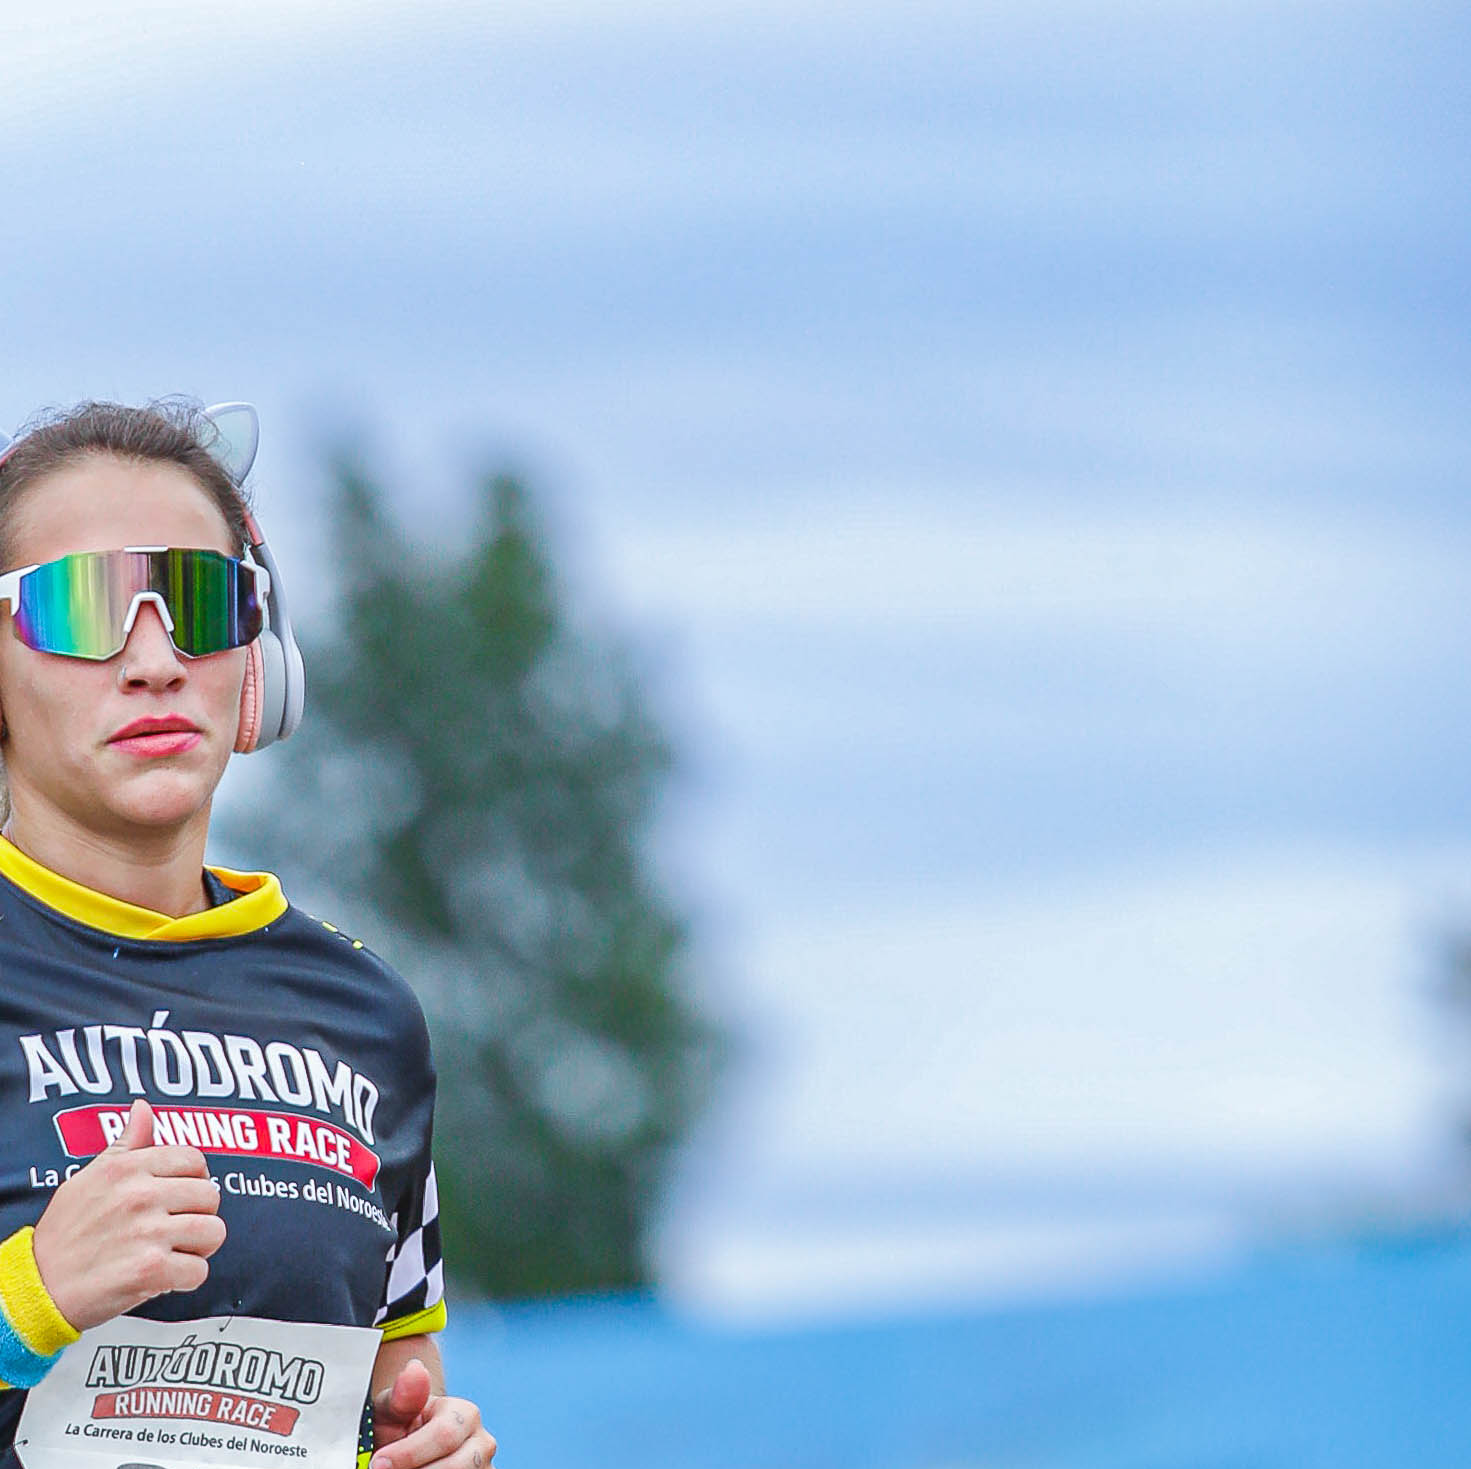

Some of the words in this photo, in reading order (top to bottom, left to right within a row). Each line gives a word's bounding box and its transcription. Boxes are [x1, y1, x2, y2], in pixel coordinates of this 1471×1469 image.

[19, 1010, 380, 1145] AUTÓDROMO
[98, 1111, 260, 1151] RNNING
[269, 1124, 354, 1174] RACE
[30, 1166, 59, 1188] La
[226, 1172, 300, 1200] Clubes
[305, 1177, 334, 1206] del
[85, 1334, 325, 1404] AUTÓDROMO
[114, 1391, 212, 1419] RUNNING
[216, 1402, 278, 1430] RACE
[65, 1422, 81, 1436] La
[83, 1424, 133, 1441] Carrera
[136, 1428, 154, 1444] de
[156, 1430, 177, 1445] los
[179, 1432, 224, 1450] Clubes
[226, 1437, 248, 1452] del
[250, 1439, 308, 1458] Noroeste
